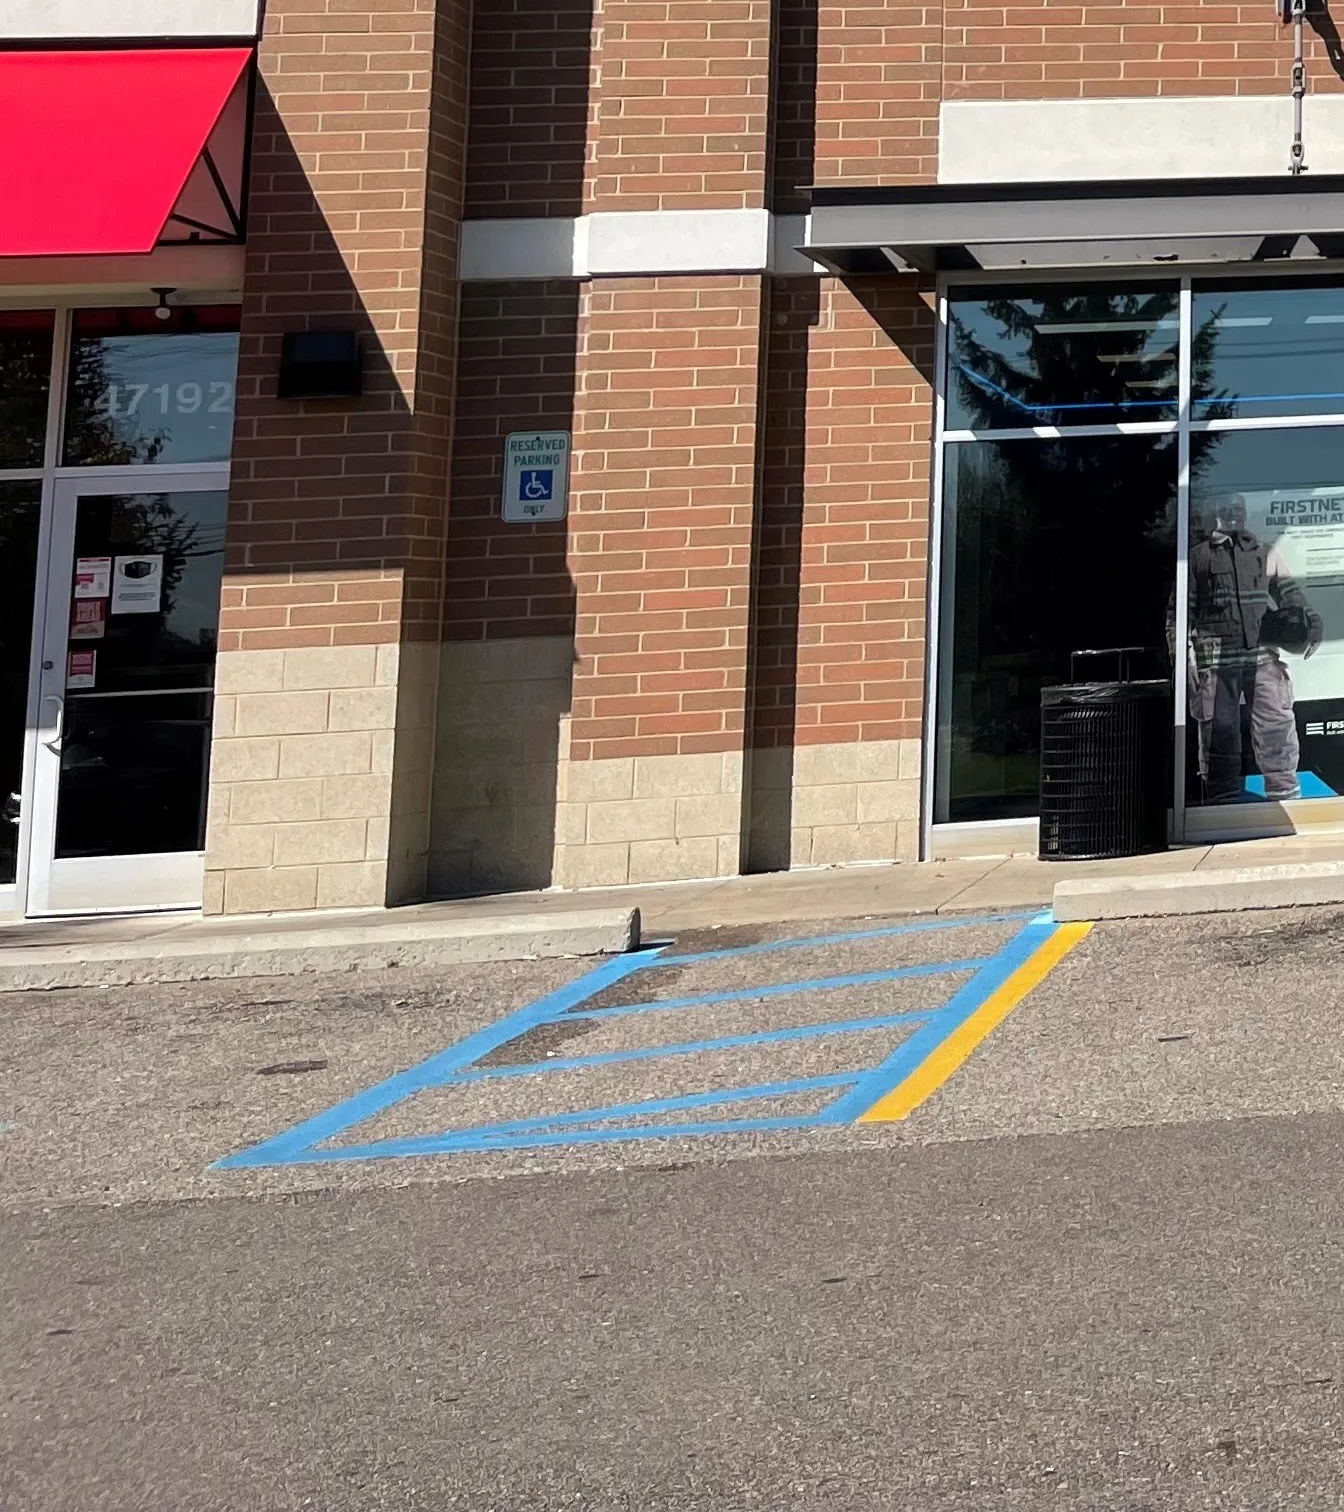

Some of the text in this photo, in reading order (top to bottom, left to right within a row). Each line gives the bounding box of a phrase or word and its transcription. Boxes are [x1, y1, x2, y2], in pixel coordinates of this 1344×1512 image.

[93, 381, 234, 416] 47192
[510, 438, 566, 452] RESERVED
[514, 454, 560, 467] PARKING
[523, 504, 545, 515] ONLY
[1265, 515, 1296, 526] BUILT
[1298, 513, 1328, 525] WITH
